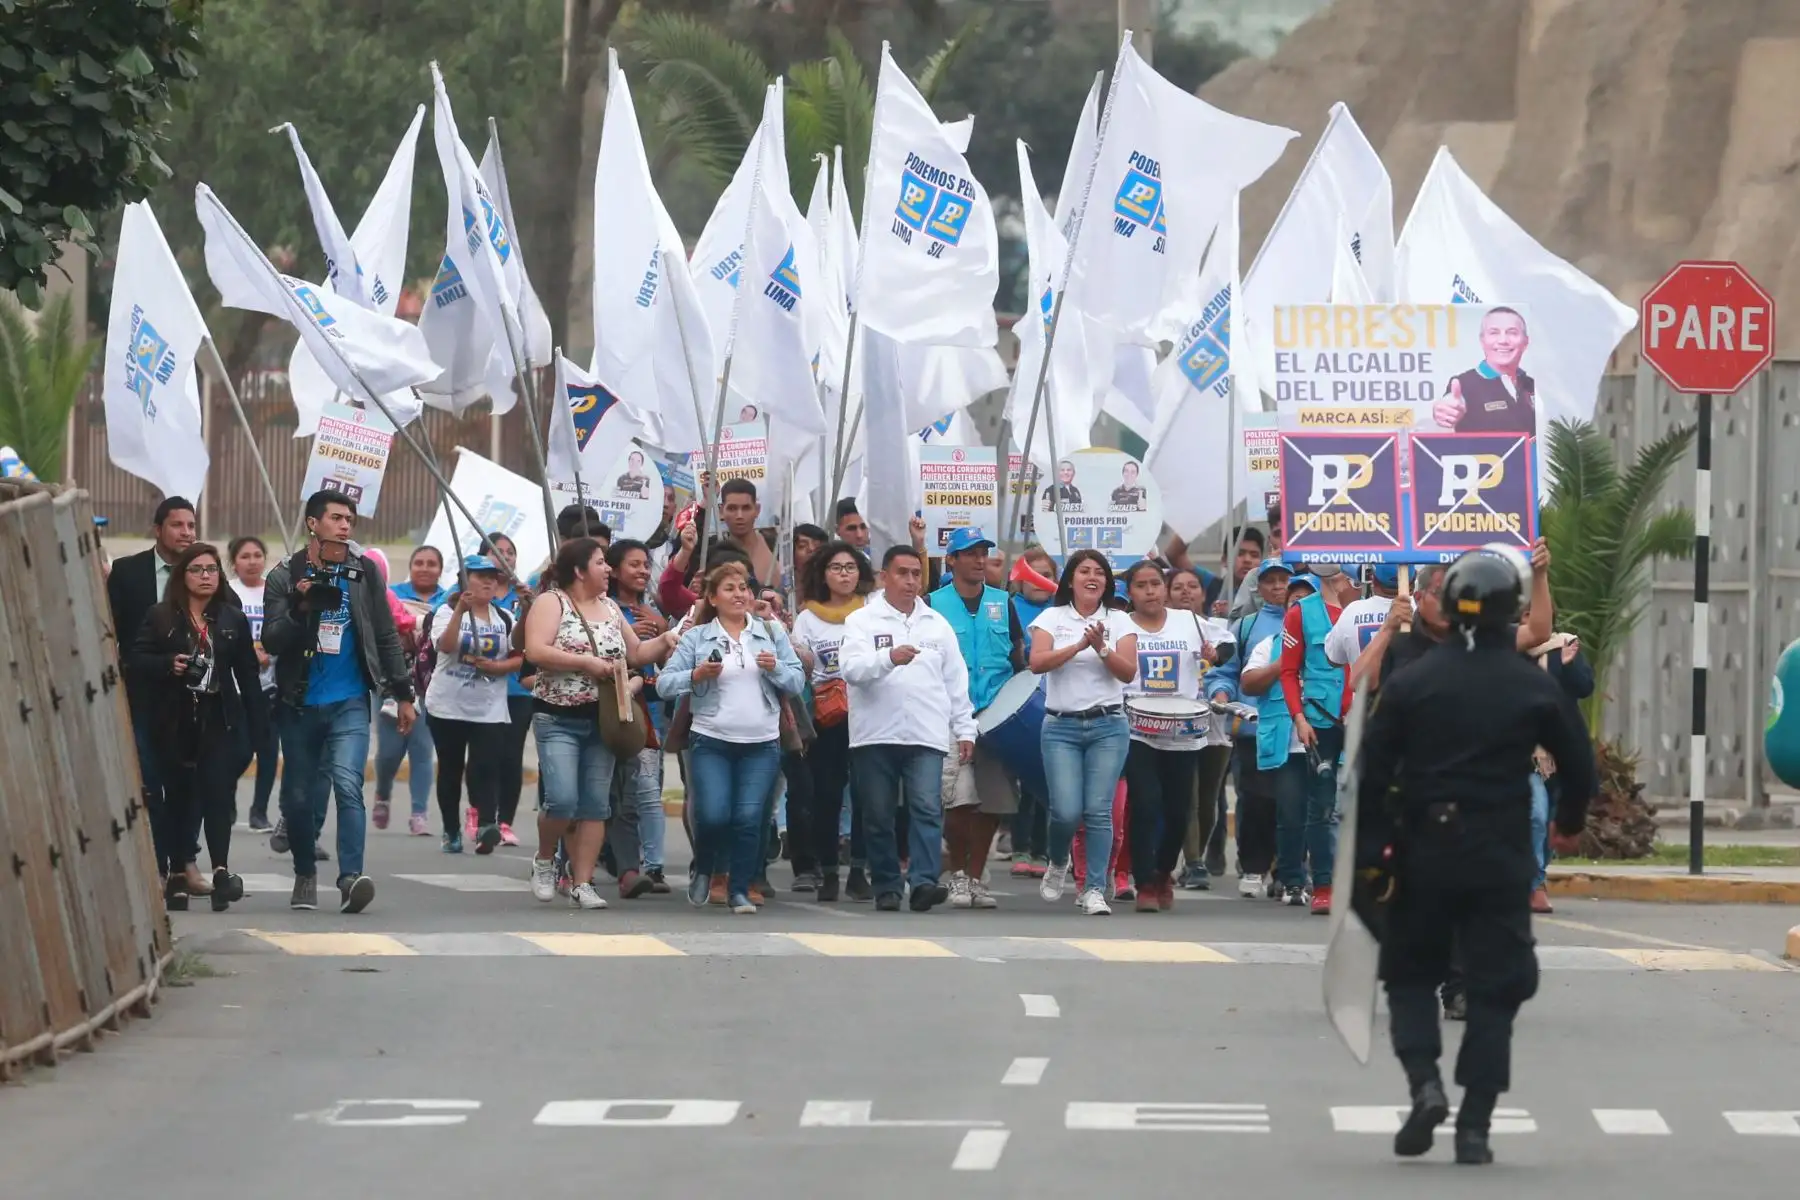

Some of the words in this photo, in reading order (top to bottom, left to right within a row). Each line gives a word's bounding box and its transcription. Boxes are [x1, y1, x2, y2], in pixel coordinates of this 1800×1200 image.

[904, 152, 956, 190] PODEMOS
[1128, 150, 1161, 178] PODE
[891, 218, 913, 246] LIMA
[1113, 216, 1137, 238] IMA
[764, 281, 796, 312] LIMA
[1274, 304, 1458, 349] URRESTI
[1650, 303, 1764, 351] PARE
[1275, 352, 1306, 373] EL
[1314, 352, 1433, 373] ALCALDE
[1276, 380, 1324, 401] DEL
[1332, 380, 1435, 401] PUEBLO
[1301, 411, 1356, 424] MARCA
[331, 448, 381, 469] PODEMOS
[957, 465, 996, 473] CORRUPTOS
[925, 482, 948, 490] JUNTOS
[572, 497, 609, 508] PDEMOS
[940, 494, 992, 505] PODEMOS
[1064, 517, 1104, 525] PODEMOS
[1294, 512, 1391, 532] PODEMOS
[1424, 512, 1521, 532] PODEMOS
[1302, 553, 1385, 564] PROVINCIAL
[1354, 613, 1374, 625] ALEX
[817, 640, 840, 650] URREST
[1148, 640, 1188, 651] GONZALES
